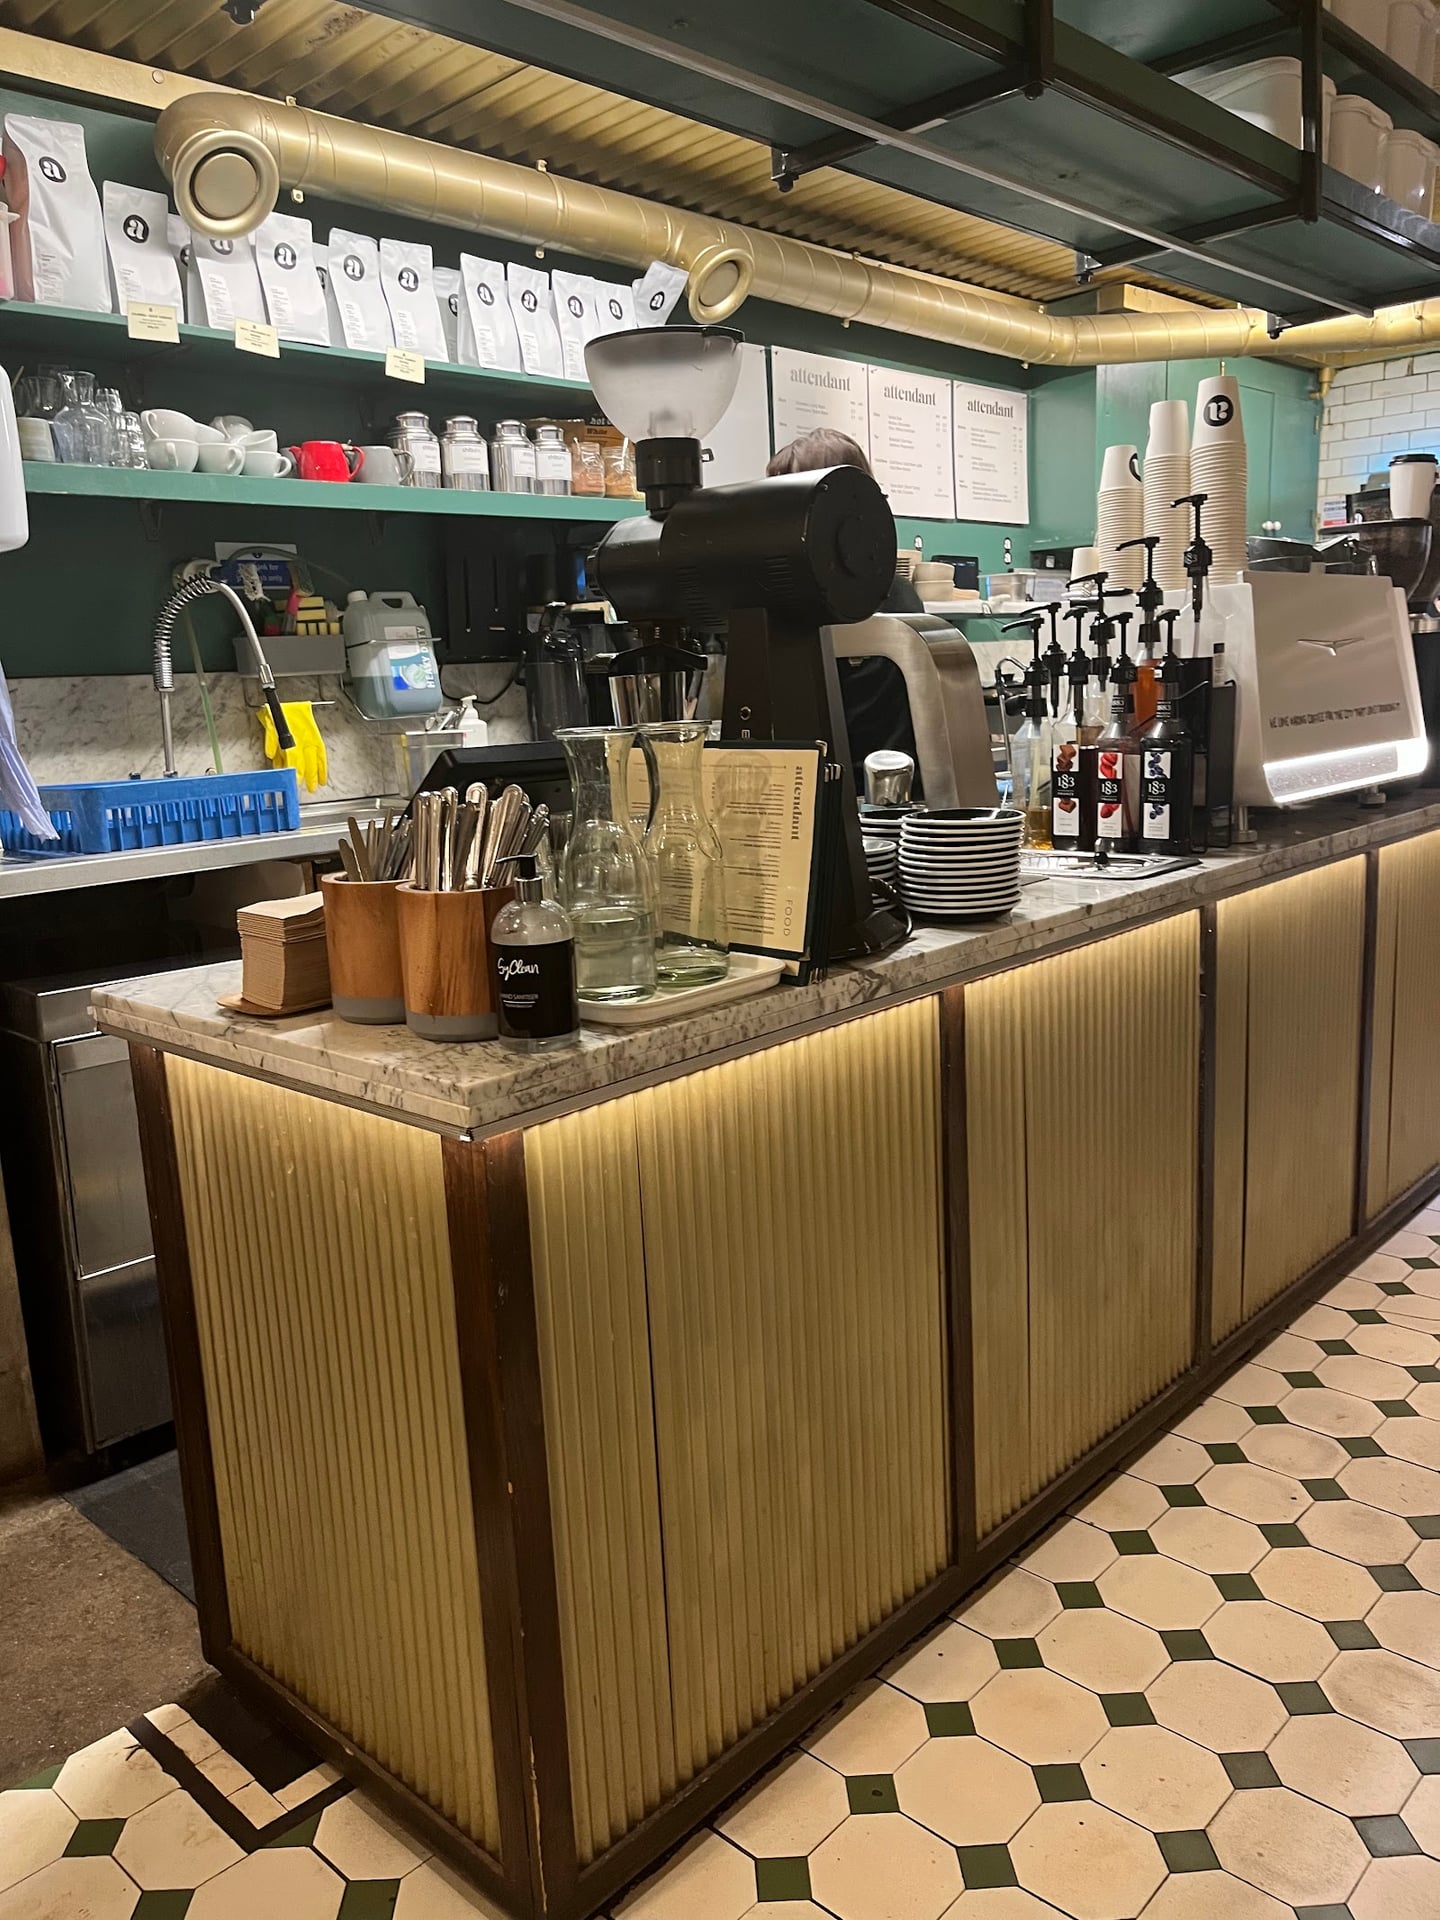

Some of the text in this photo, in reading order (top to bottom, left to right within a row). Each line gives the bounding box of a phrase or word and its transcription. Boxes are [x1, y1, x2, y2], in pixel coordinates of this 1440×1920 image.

[42, 160, 63, 180] a
[126, 219, 145, 240] a
[277, 247, 294, 266] a
[346, 258, 361, 278] a
[400, 271, 416, 289] a
[790, 367, 851, 392] attendant
[883, 384, 936, 406] attendant
[967, 398, 1014, 419] attendant
[791, 765, 805, 840] attendant
[783, 899, 794, 937] FOOD
